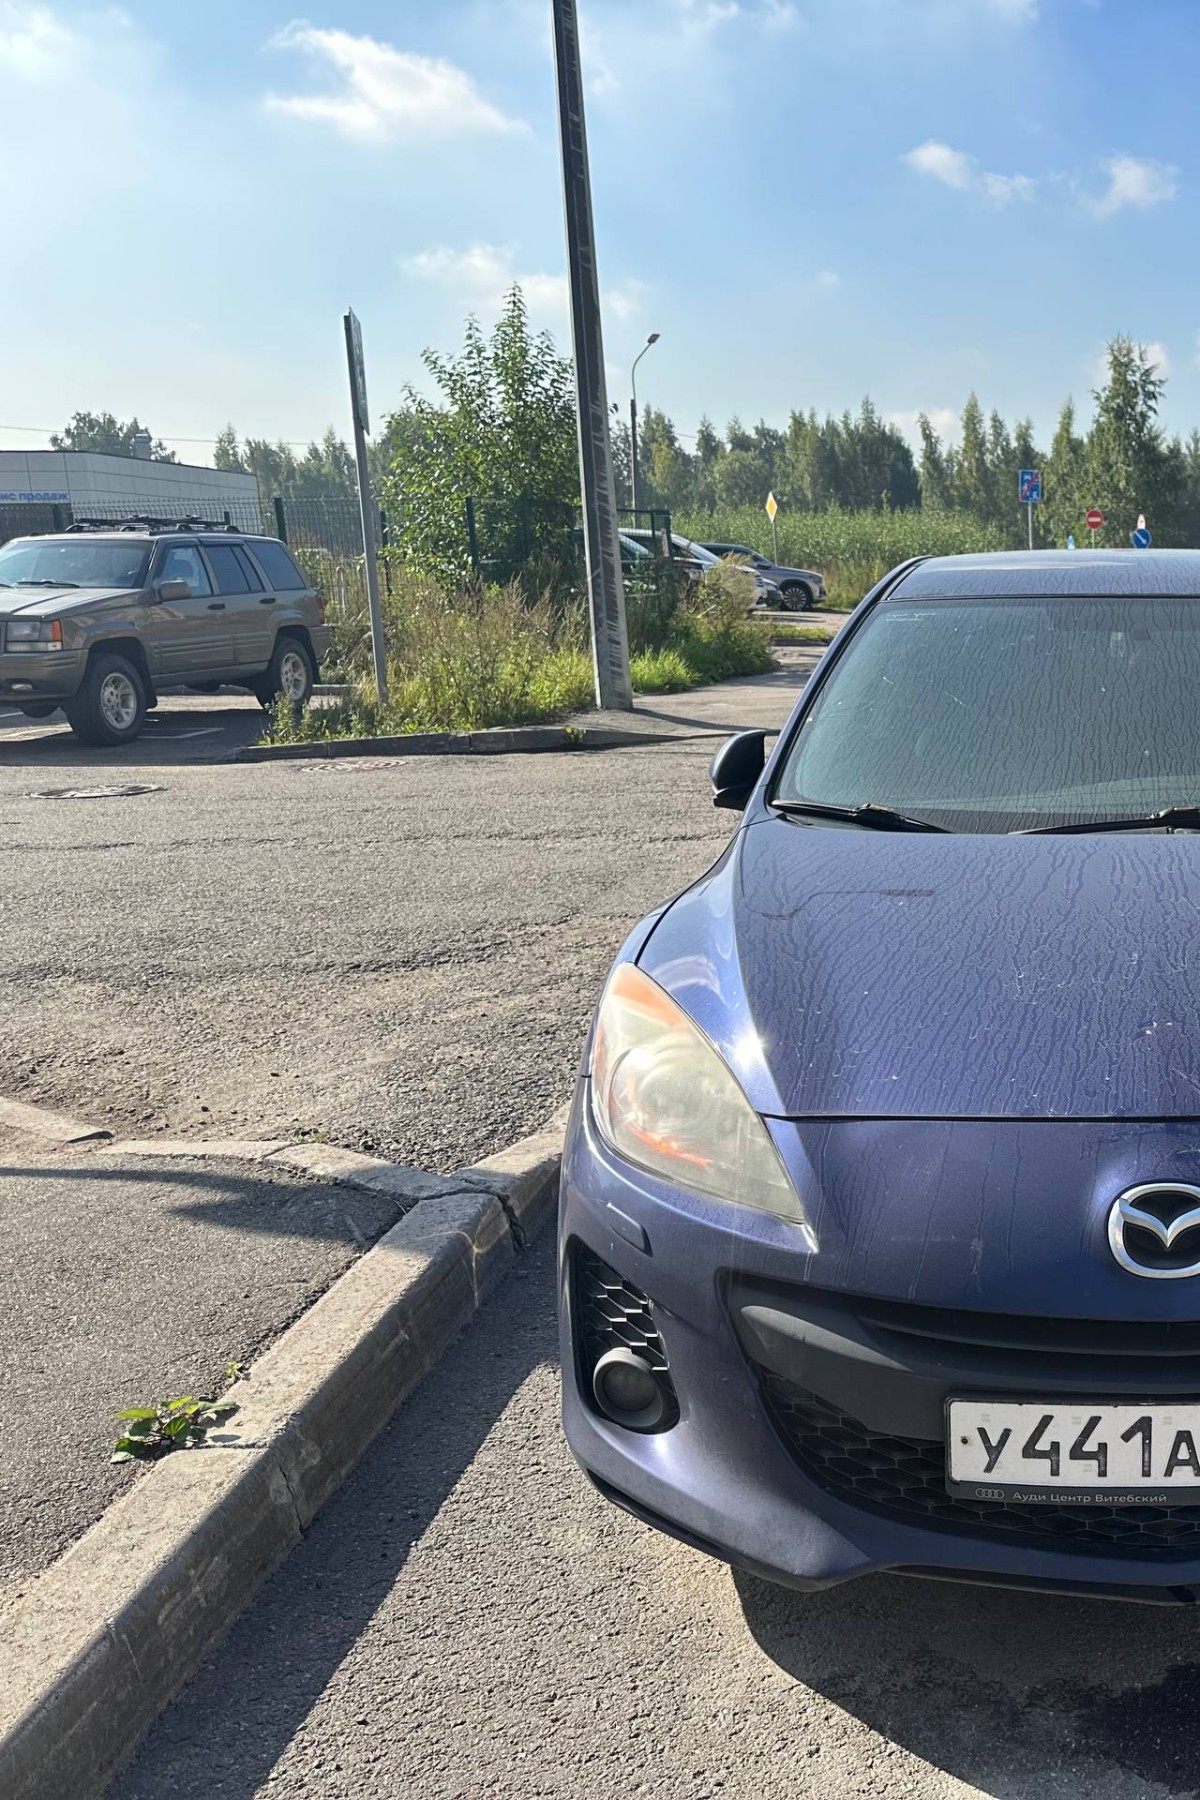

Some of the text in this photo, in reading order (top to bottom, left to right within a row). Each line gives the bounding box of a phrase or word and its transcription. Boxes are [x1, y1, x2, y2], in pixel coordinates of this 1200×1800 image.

[1012, 1491, 1168, 1504] Ауди Центр Витебский
